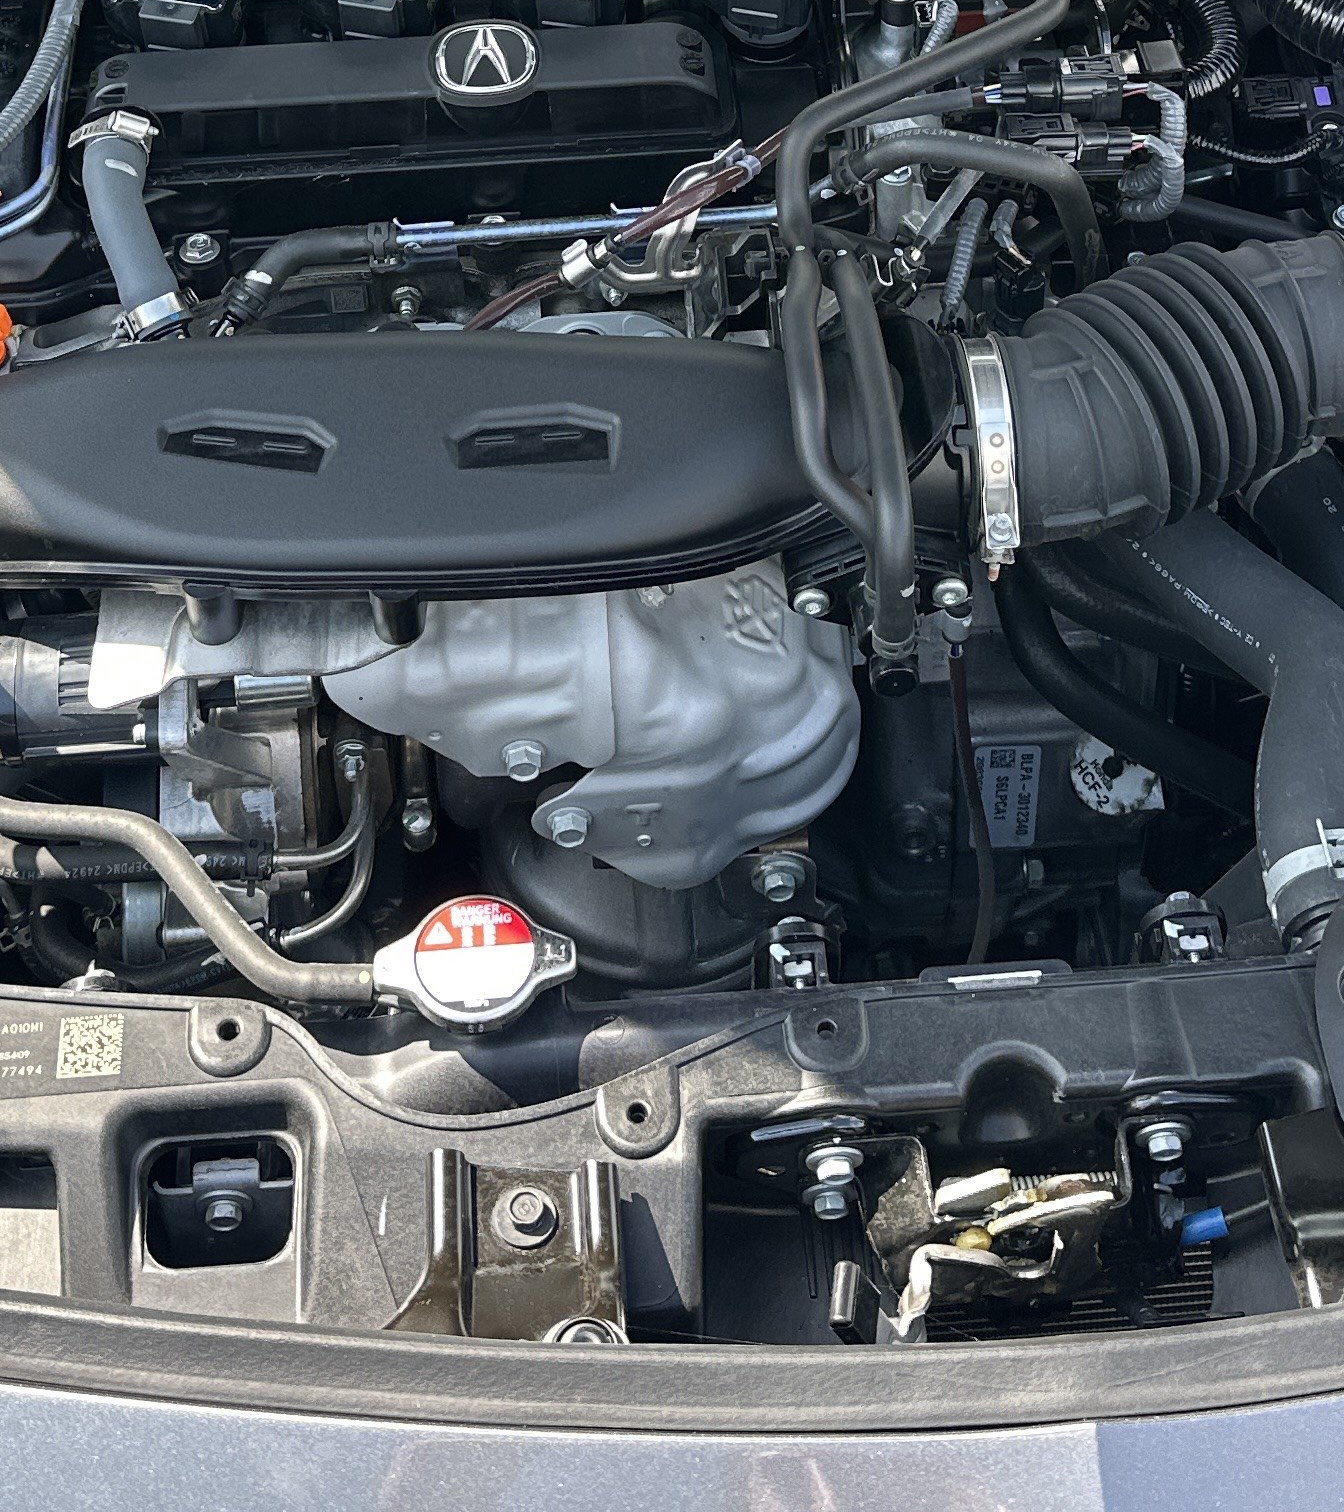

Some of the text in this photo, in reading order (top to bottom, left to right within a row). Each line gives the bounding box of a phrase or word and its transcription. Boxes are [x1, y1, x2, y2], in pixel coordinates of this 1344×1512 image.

[1322, 497, 1338, 514] 20
[1074, 758, 1110, 809] HCF-2
[450, 902, 501, 917] DANGER
